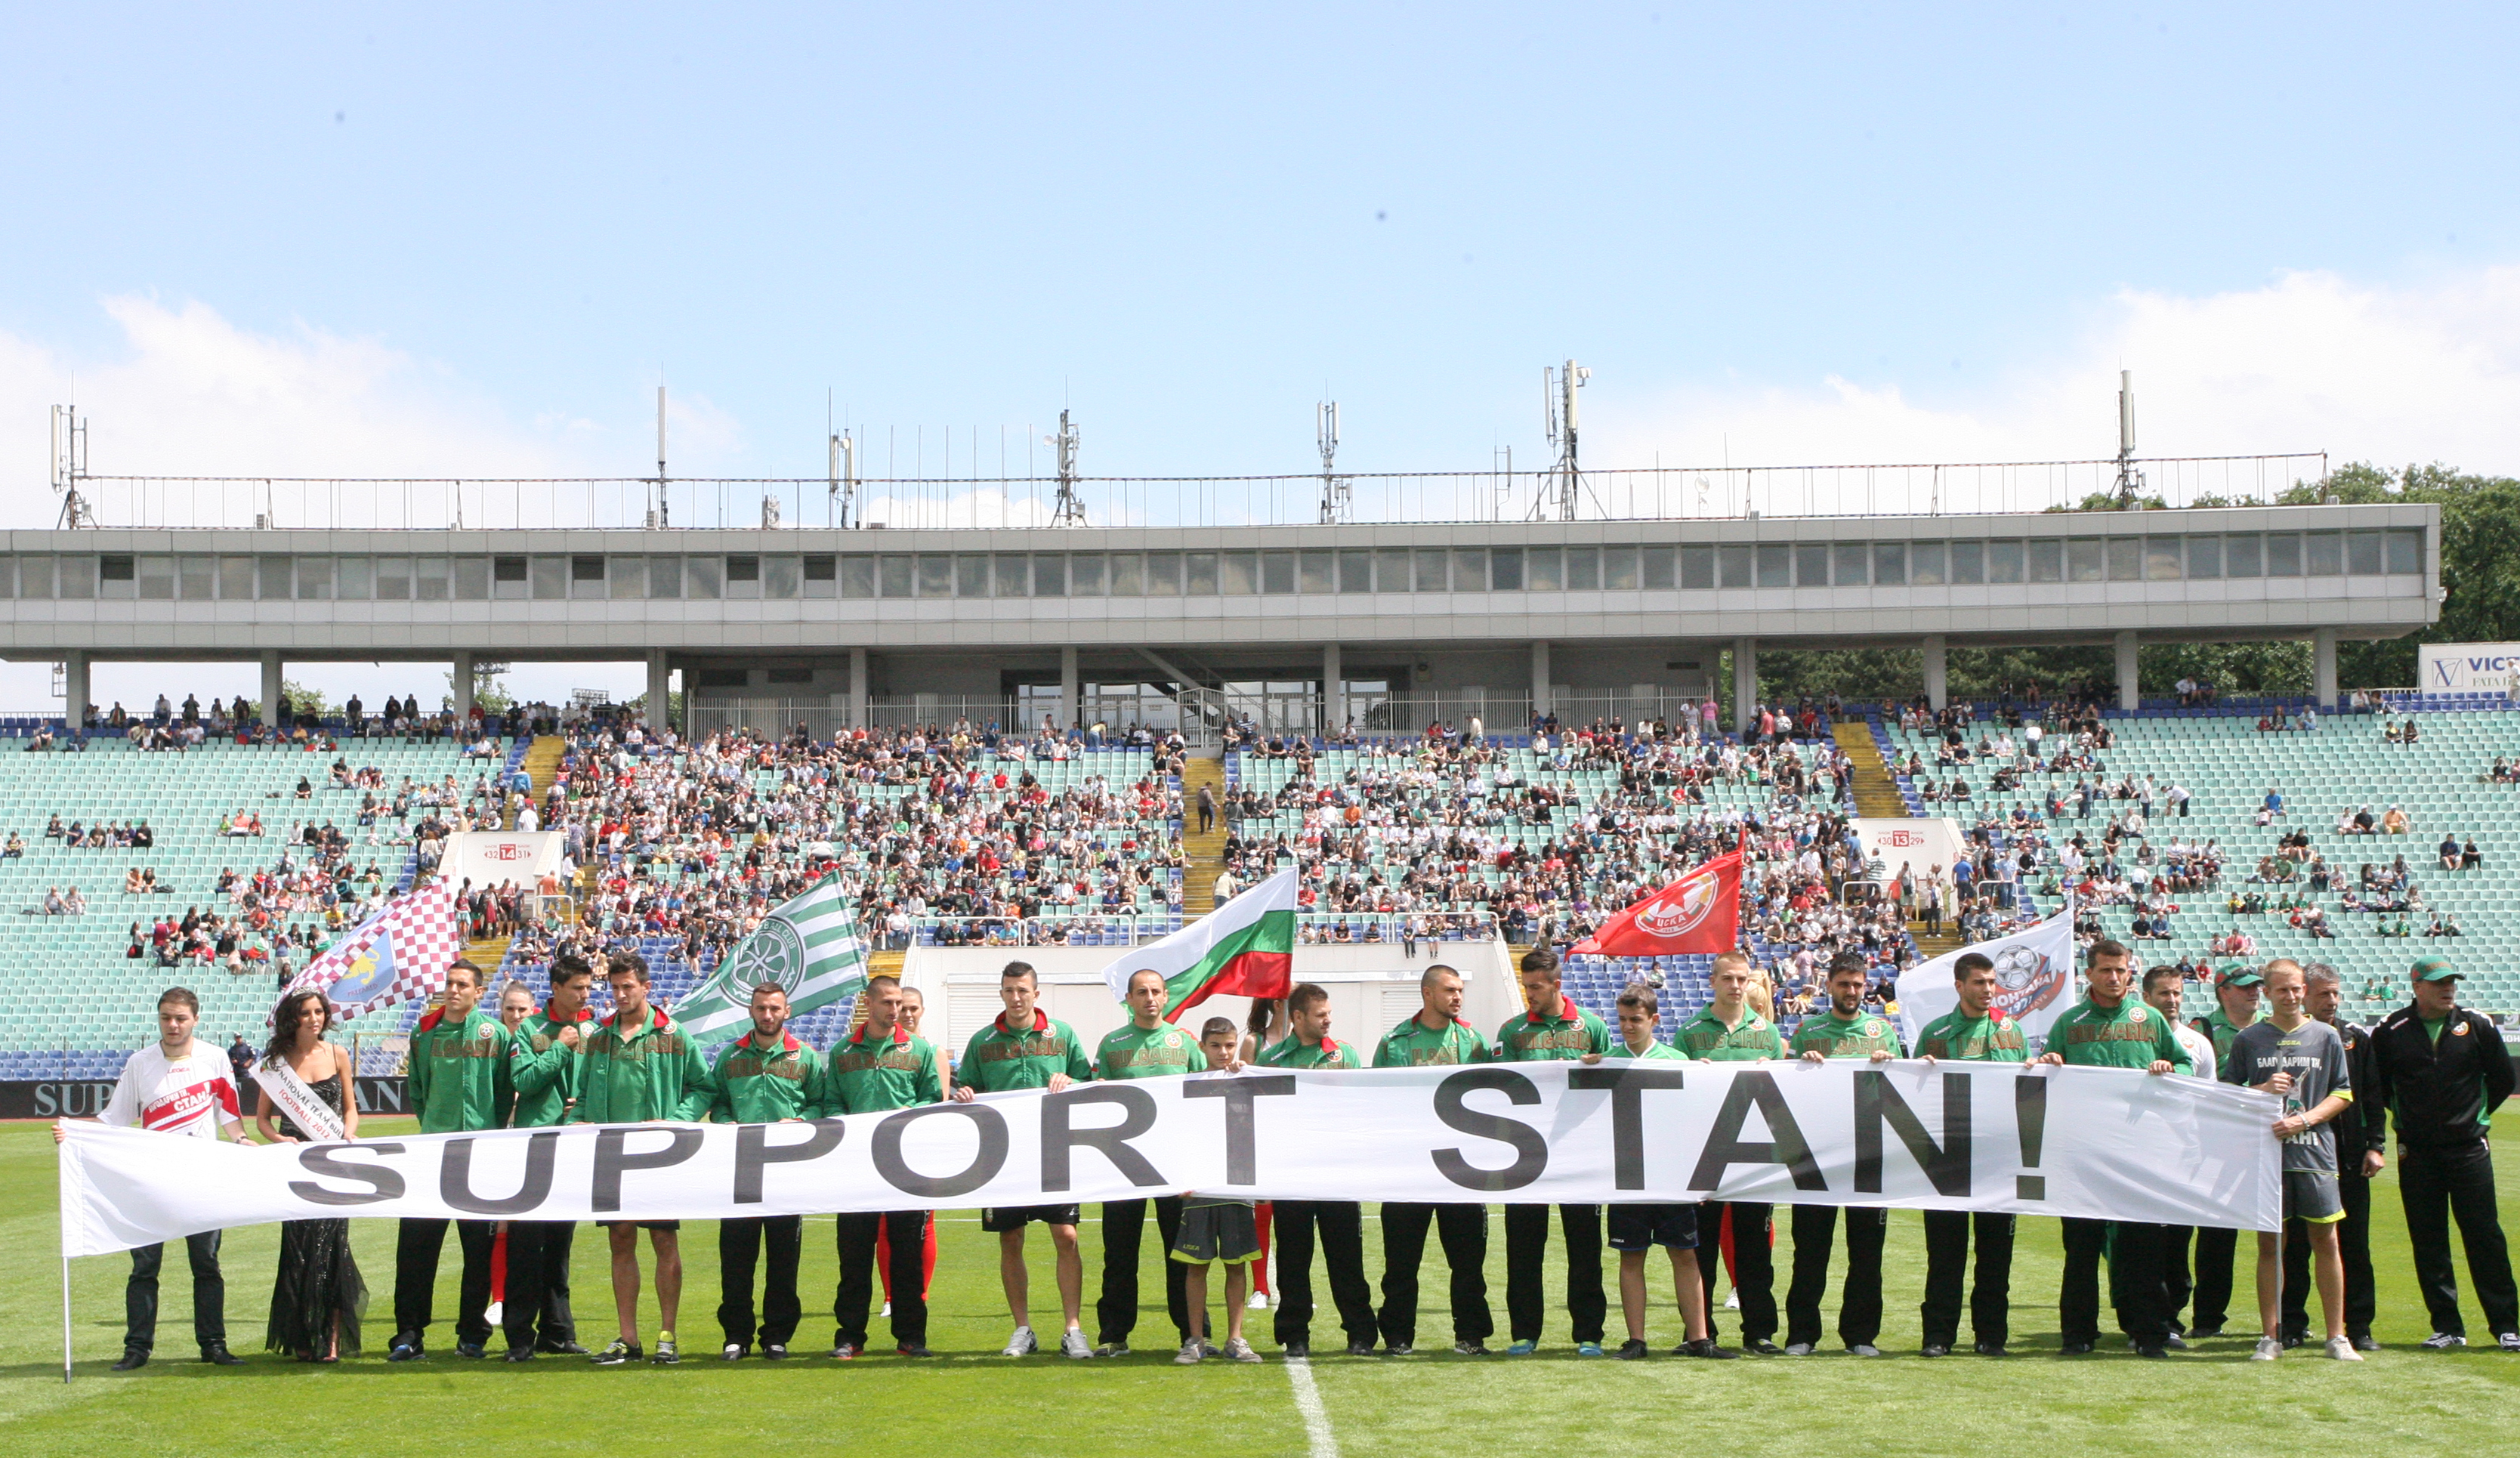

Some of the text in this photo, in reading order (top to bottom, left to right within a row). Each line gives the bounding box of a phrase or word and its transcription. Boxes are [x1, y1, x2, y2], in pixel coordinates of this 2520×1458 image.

[1882, 836, 1920, 845] 30 13 29
[488, 849, 527, 859] 32 14 31
[782, 929, 797, 950] CLUB
[2067, 1022, 2158, 1045] BULGARIA
[1107, 1046, 1189, 1070] BULGARIA
[2256, 1057, 2310, 1068] БЛАГДАРИМ
[173, 1081, 211, 1112] СТАН!
[278, 1070, 310, 1106] NATIONAL
[310, 1104, 331, 1125] TEAM
[329, 1122, 343, 1139] BUL
[278, 1089, 331, 1139] FOOTBALL 2012
[288, 1067, 2048, 1215] SUPPORT STAN!
[2284, 1131, 2319, 1147] АН!
